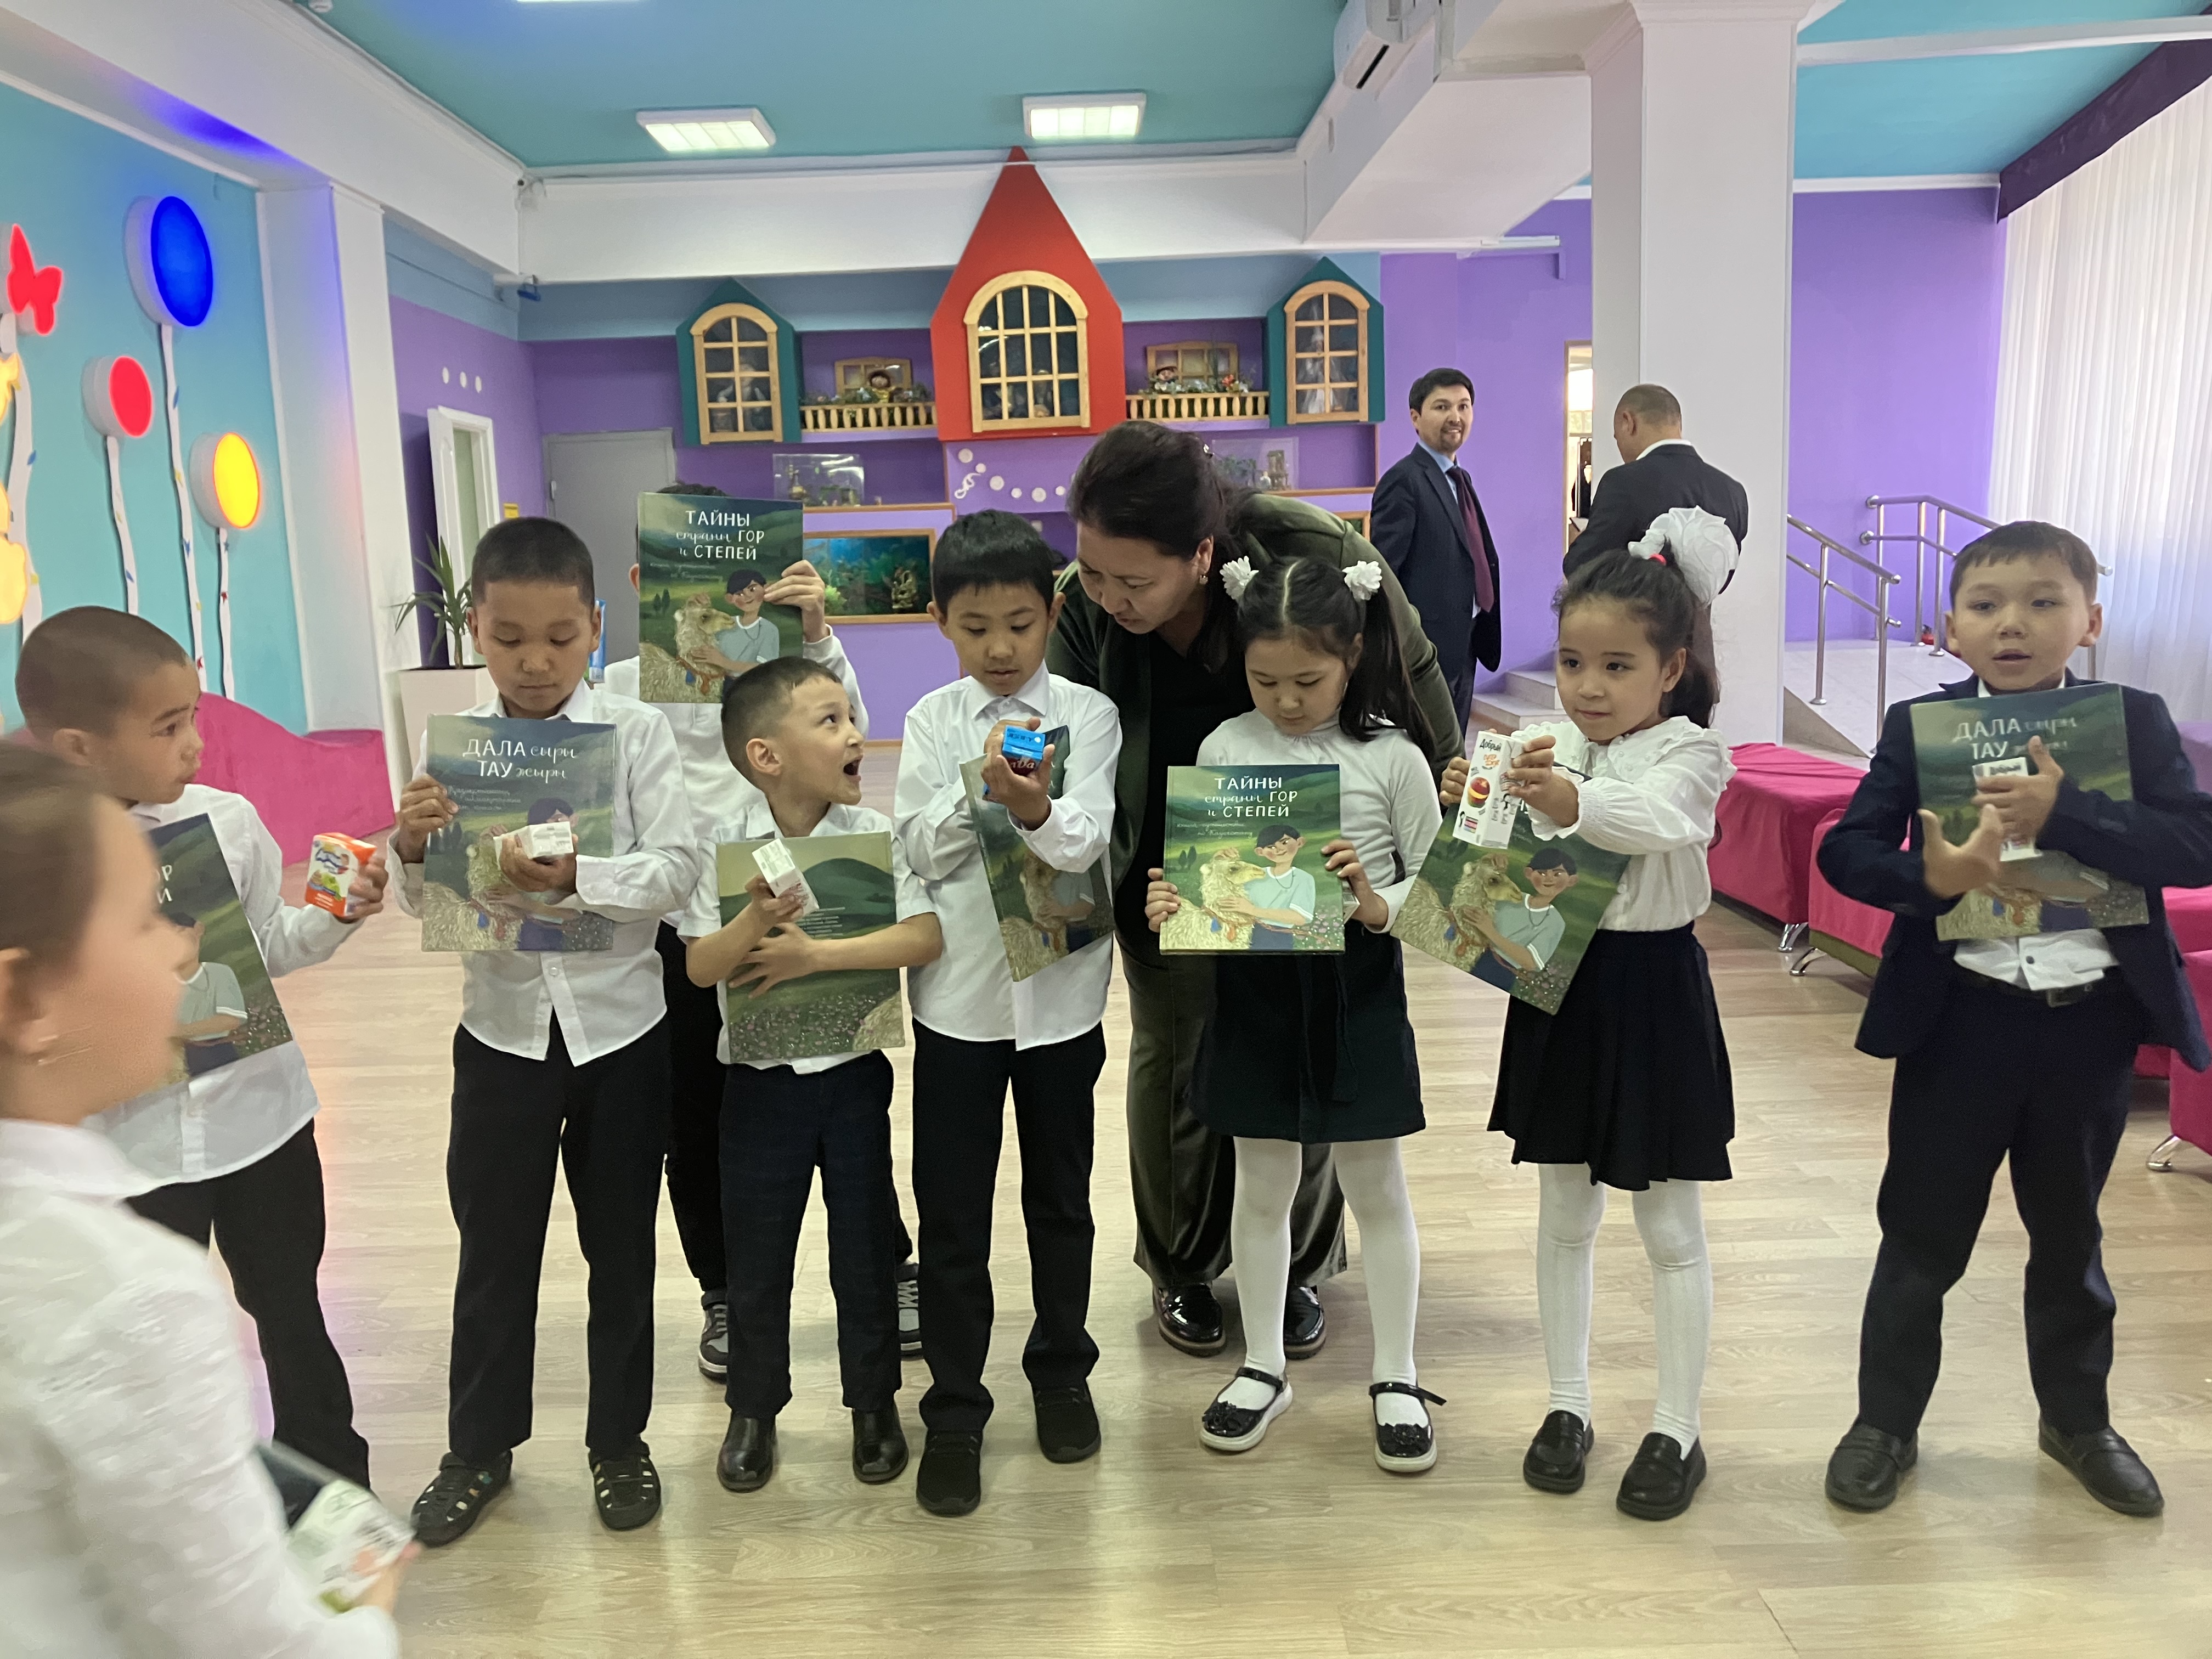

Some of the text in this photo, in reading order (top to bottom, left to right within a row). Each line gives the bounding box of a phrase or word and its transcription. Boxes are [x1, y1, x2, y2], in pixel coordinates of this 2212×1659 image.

[685, 509, 750, 527] ТАЙНЫ
[676, 529, 765, 544] страны ГОР
[679, 545, 757, 560] и СТЕПЕЙ
[1953, 718, 2022, 743] ДАЛА
[462, 739, 578, 764] ДАЛА сыры
[1971, 741, 2008, 760] ТАУ
[477, 760, 566, 783] ТАУ жыры
[1214, 775, 1282, 789] ТАЙНЫ
[1204, 791, 1298, 806] страны ГОР
[1223, 804, 1289, 817] СТЕПЕЙ
